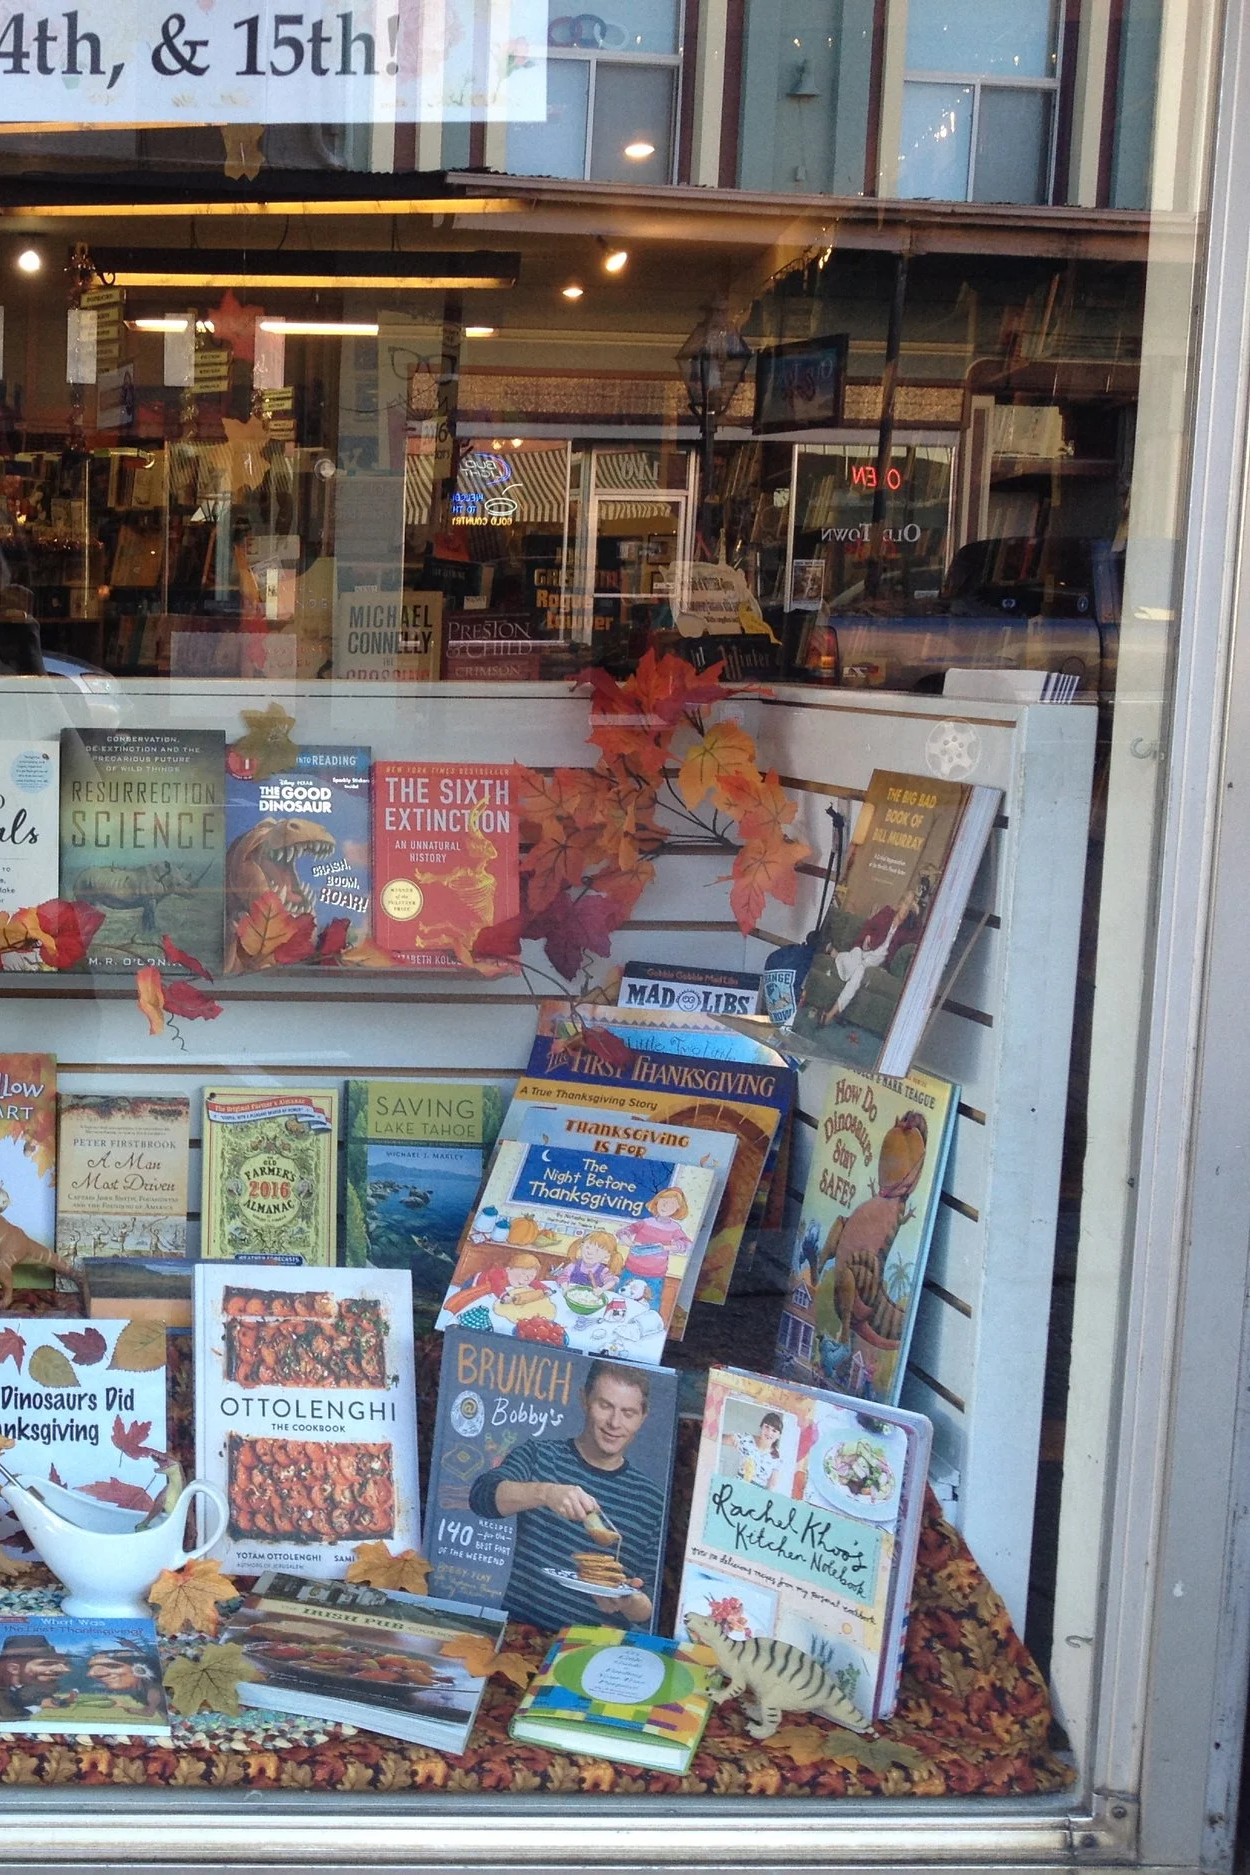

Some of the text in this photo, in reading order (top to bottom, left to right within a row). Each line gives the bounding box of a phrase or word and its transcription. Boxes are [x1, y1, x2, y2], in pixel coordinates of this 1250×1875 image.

[151, 12, 210, 77] &
[234, 9, 400, 77] 15th!
[535, 588, 593, 612] Rogue
[349, 604, 433, 628] MICHAEL
[348, 630, 433, 654] CONNELLY
[447, 620, 532, 640] PRESTON
[466, 641, 533, 658] CHILD
[454, 663, 521, 676] CRIMSON
[72, 780, 215, 805] RESURRECTION
[259, 786, 332, 800] THE GOOD
[385, 777, 509, 805] THE SIXTH
[259, 800, 332, 813] DINOSAUR
[72, 810, 215, 850] SCIENCE
[385, 808, 510, 833] EXTINCTION
[395, 840, 461, 851] AN UNNATURAL
[409, 853, 447, 863] HISTORY
[625, 983, 750, 1016] MAD LIBS
[834, 1078, 863, 1105] How
[376, 1096, 475, 1119] SAVING
[374, 1121, 476, 1138] LAKE TAHOE
[824, 1110, 873, 1168] Dinosaurs
[73, 1138, 176, 1149] PETER FIRSTBROOK
[592, 1139, 648, 1158] IS FOR
[263, 1159, 277, 1167] OLD
[582, 1157, 608, 1173] The
[832, 1138, 857, 1177] Stay
[244, 1165, 297, 1183] FARMER'S
[543, 1167, 637, 1193] Night Before
[248, 1180, 291, 1199] 2016
[528, 1180, 645, 1217] Thanksgiving
[819, 1168, 857, 1209] SAFE?
[243, 1200, 295, 1215] ALMANAC
[456, 1343, 572, 1406] BRUNCH
[1, 1386, 98, 1412] Dinosaurs
[105, 1387, 135, 1411] Did
[220, 1396, 397, 1422] OTTOLENGHI
[271, 1423, 346, 1433] THE COOKBOOK
[438, 1518, 513, 1546] 140 RECIPES
[713, 1484, 868, 1572] Rachel Khoo's
[236, 1552, 266, 1560] YOTAM
[267, 1553, 322, 1562] OTTOLENGHI
[734, 1521, 867, 1599] Kitchen Notebook
